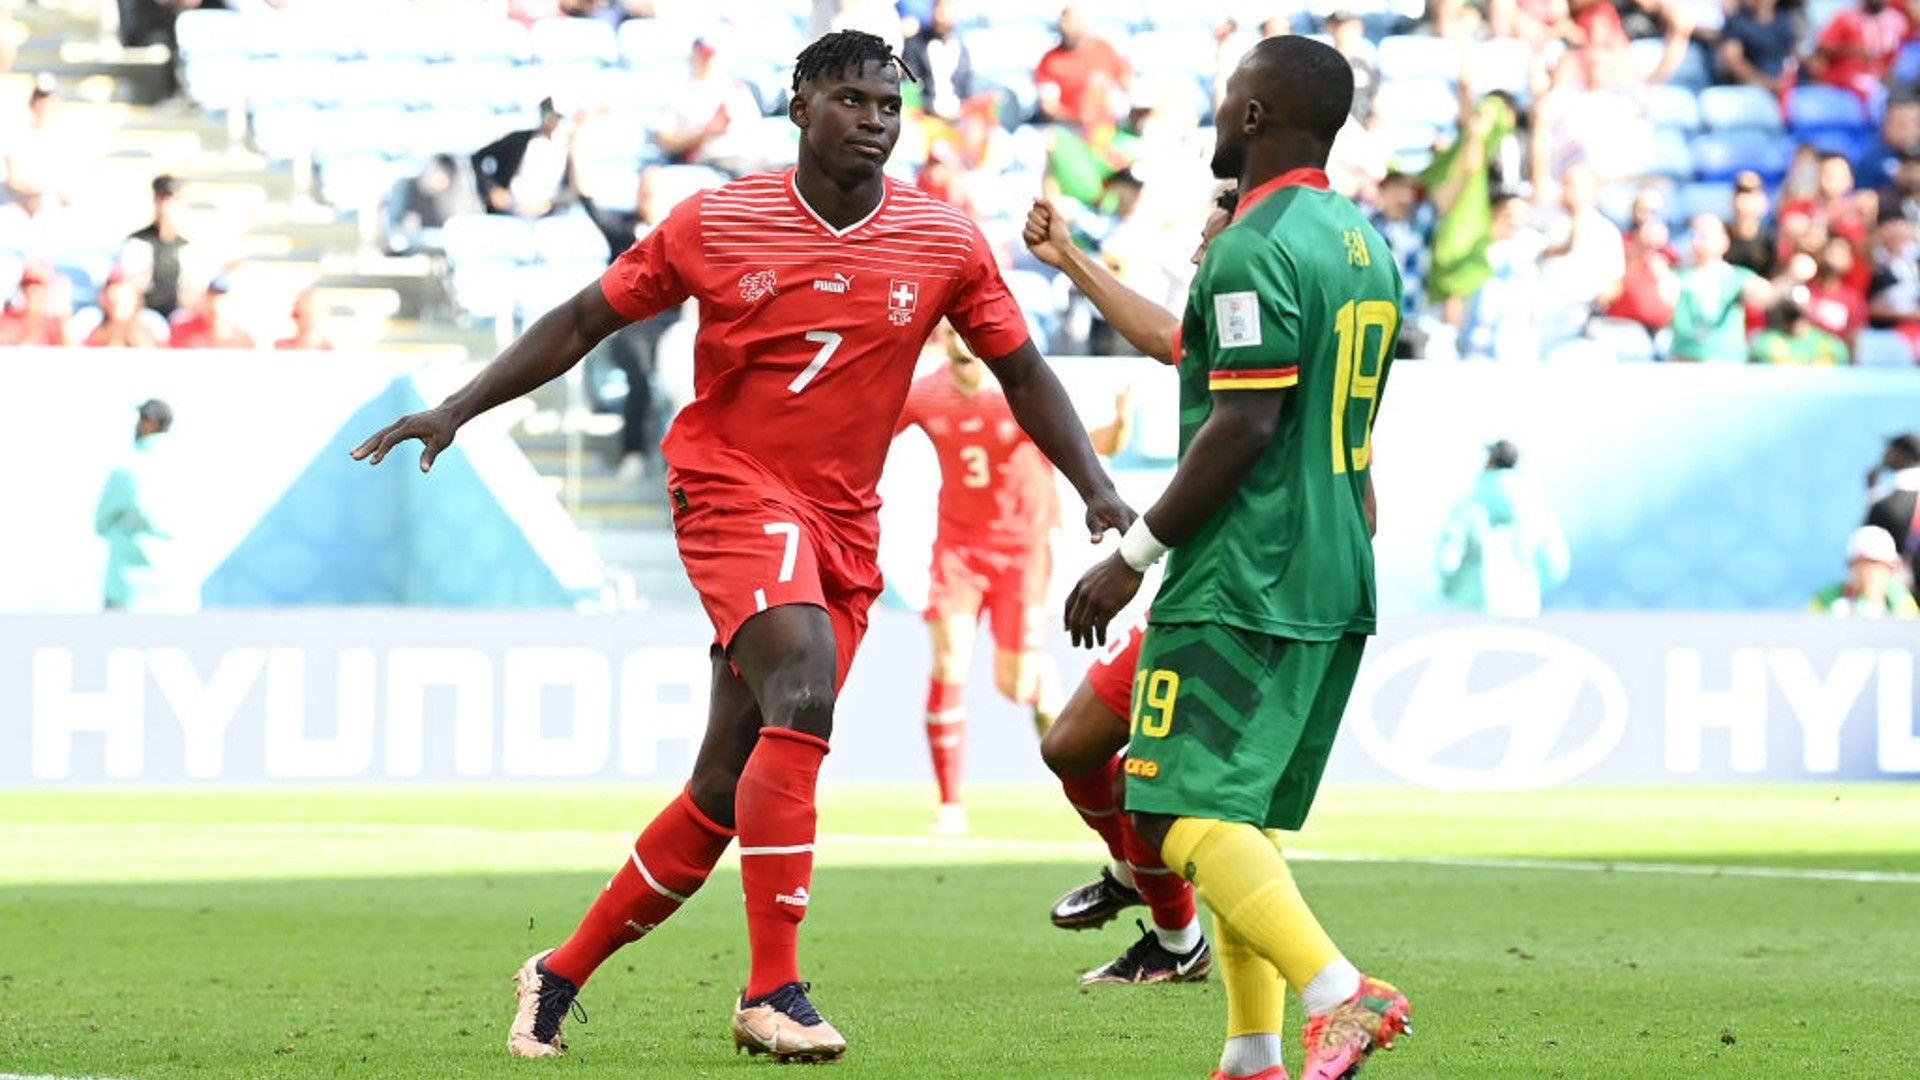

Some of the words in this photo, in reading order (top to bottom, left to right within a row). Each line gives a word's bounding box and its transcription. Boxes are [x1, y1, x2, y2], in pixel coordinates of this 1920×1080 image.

[813, 279, 845, 294] PUMA
[787, 331, 842, 393] 7
[1331, 299, 1397, 474] 19
[960, 445, 990, 488] 3
[763, 522, 799, 583] 7
[32, 647, 712, 778] HYUNDA
[1130, 669, 1179, 737] 19
